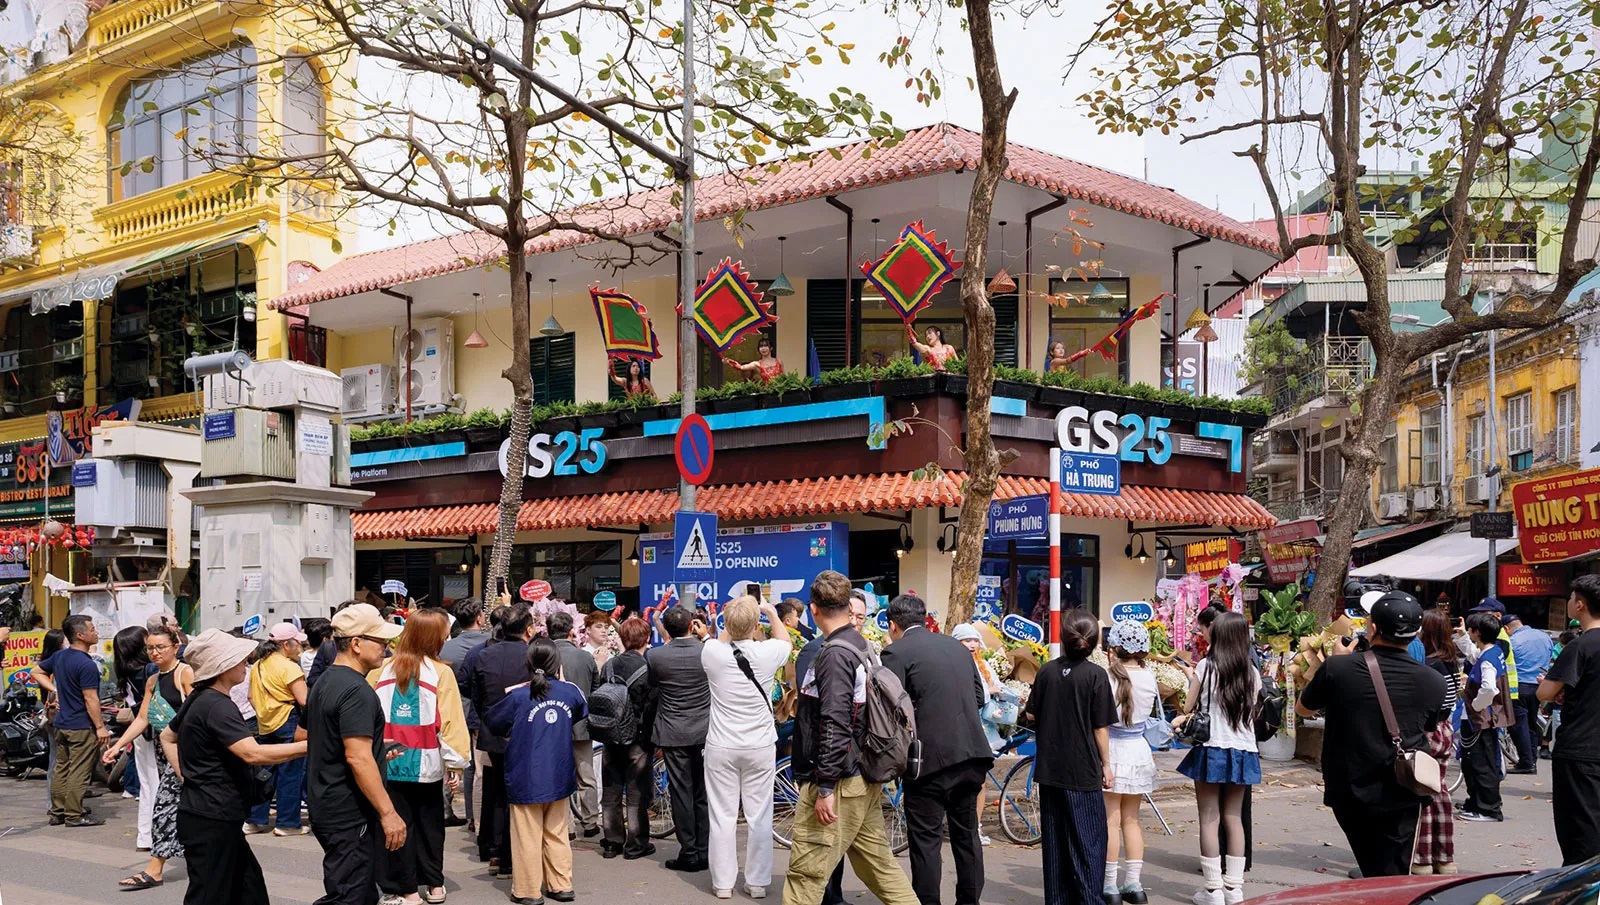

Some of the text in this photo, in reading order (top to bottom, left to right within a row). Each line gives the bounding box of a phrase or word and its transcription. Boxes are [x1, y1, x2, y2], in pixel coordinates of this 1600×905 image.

[1054, 405, 1173, 465] GS25
[1080, 459, 1100, 470] PHỐ
[361, 468, 388, 478] Platform
[1066, 469, 1114, 489] HÀ TRUNG
[1532, 483, 1548, 493] CÔNG
[1548, 482, 1556, 490] TY
[1557, 480, 1573, 488] TNHH
[0, 485, 70, 502] BISTRO RESTAURANT
[1008, 501, 1027, 514] PHỐ
[1522, 492, 1600, 529] HÙNG T
[995, 515, 1042, 533] PHÙNG HƯNG
[1533, 531, 1548, 544] GIỮ
[1549, 530, 1566, 542] CHỮ
[715, 541, 742, 554] GS25
[1540, 547, 1549, 558] 75
[725, 555, 778, 569] OPENING
[1508, 574, 1533, 585] HÙNG
[1122, 605, 1142, 613] GS25
[1006, 624, 1018, 635] XIN
[1014, 620, 1033, 633] GS25
